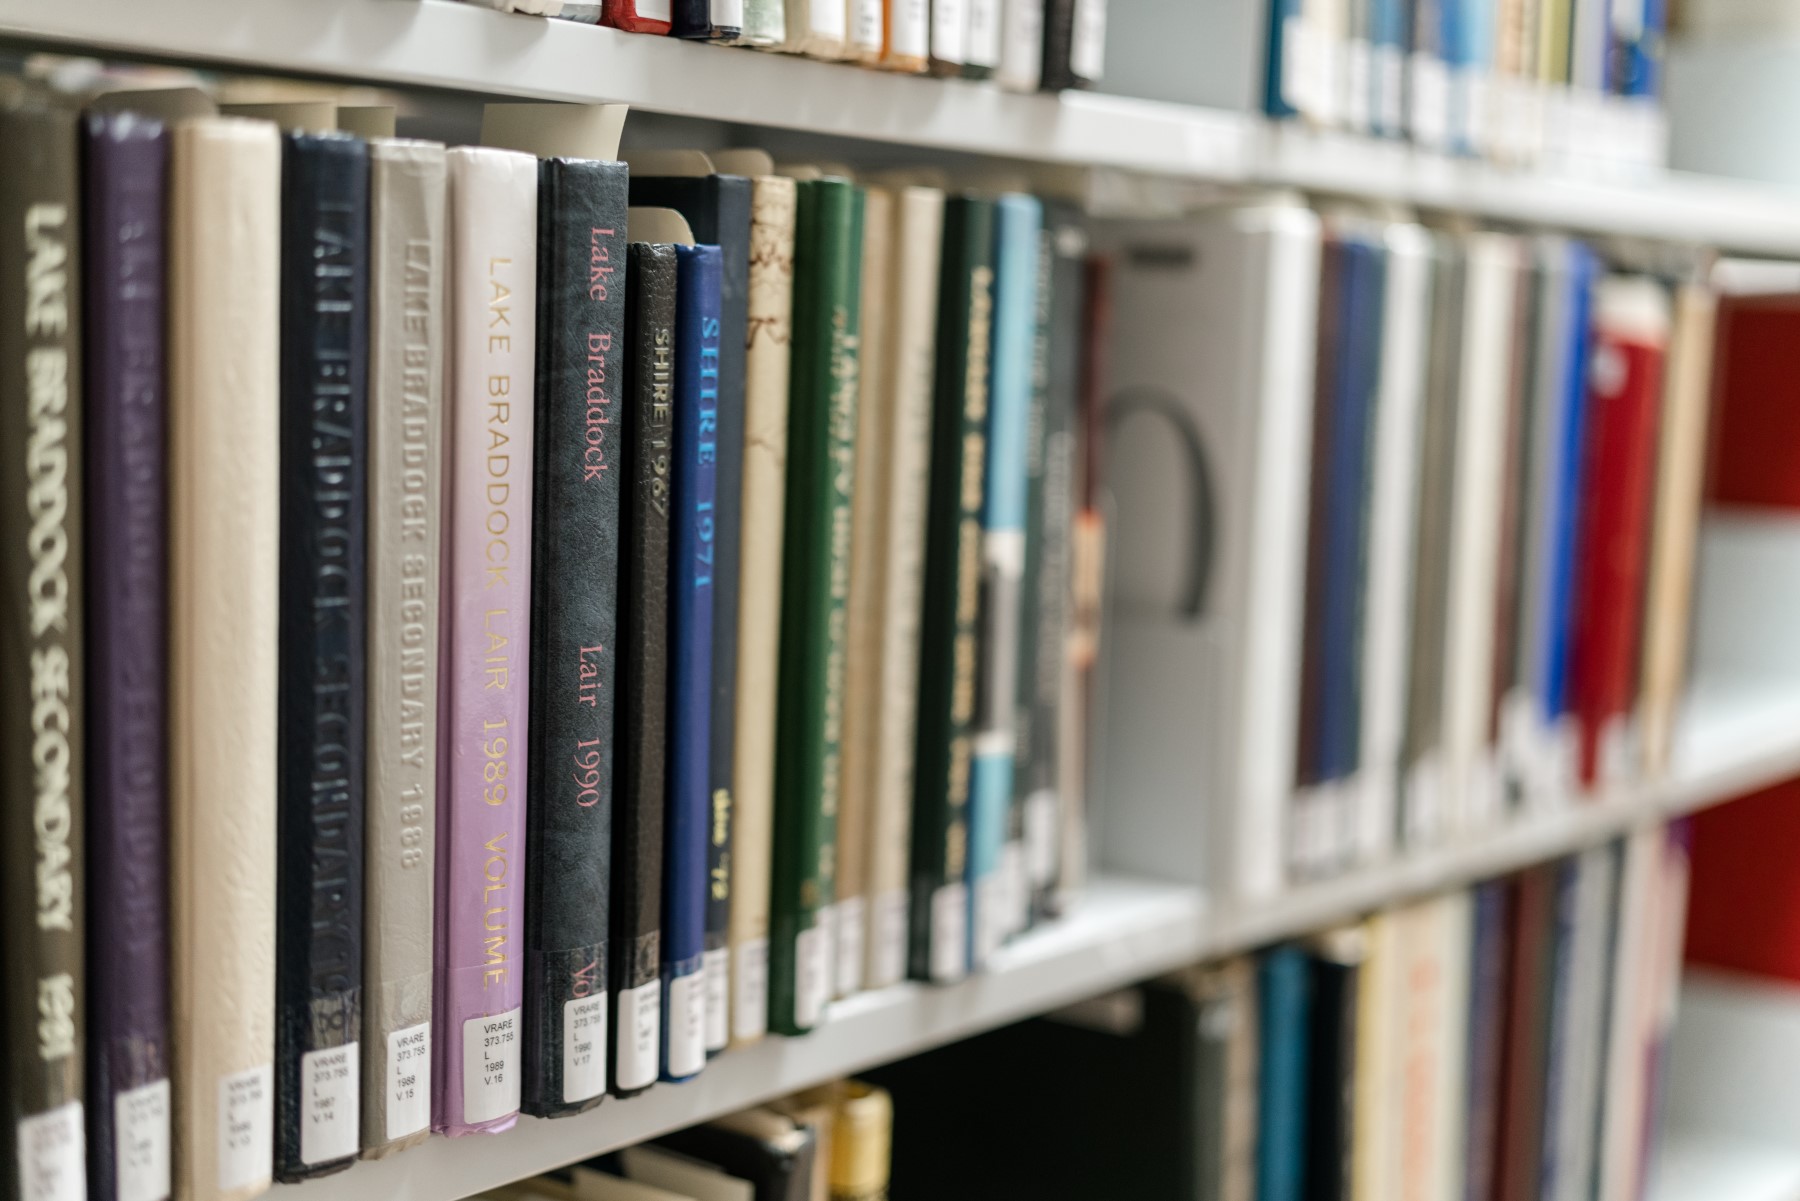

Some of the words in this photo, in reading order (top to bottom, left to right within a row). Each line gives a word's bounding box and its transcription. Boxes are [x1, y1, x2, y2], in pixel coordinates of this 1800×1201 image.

[25, 203, 67, 337] LAKE
[404, 238, 432, 333] LAKE
[488, 257, 512, 353] LAKE
[590, 226, 615, 302] Lake
[585, 333, 611, 482] Braddock
[653, 328, 670, 418] SHIRE
[698, 317, 720, 464] SHIRE
[401, 343, 429, 543] BRADDOCK
[485, 375, 511, 590] BRADDOCK
[650, 436, 668, 517] 1967
[26, 349, 68, 638] BRADDOCK
[695, 501, 715, 586] 1971
[400, 553, 427, 769] SECONDARY
[483, 609, 510, 690] LAIR
[578, 644, 603, 707] Lair
[30, 645, 74, 932] SECONDARY
[483, 718, 509, 806] 1989
[573, 738, 600, 807] 1990
[400, 782, 424, 871] 1988
[483, 832, 509, 991] VOLUME
[396, 1032, 424, 1048] VRARE
[484, 1019, 512, 1034] VRARE
[484, 1031, 513, 1047] 373.755
[573, 1001, 600, 1016] VRARE
[574, 1042, 592, 1053] 1990
[397, 1045, 425, 1062] 373.755
[398, 1075, 415, 1087] 1988
[485, 1060, 504, 1072] 1989
